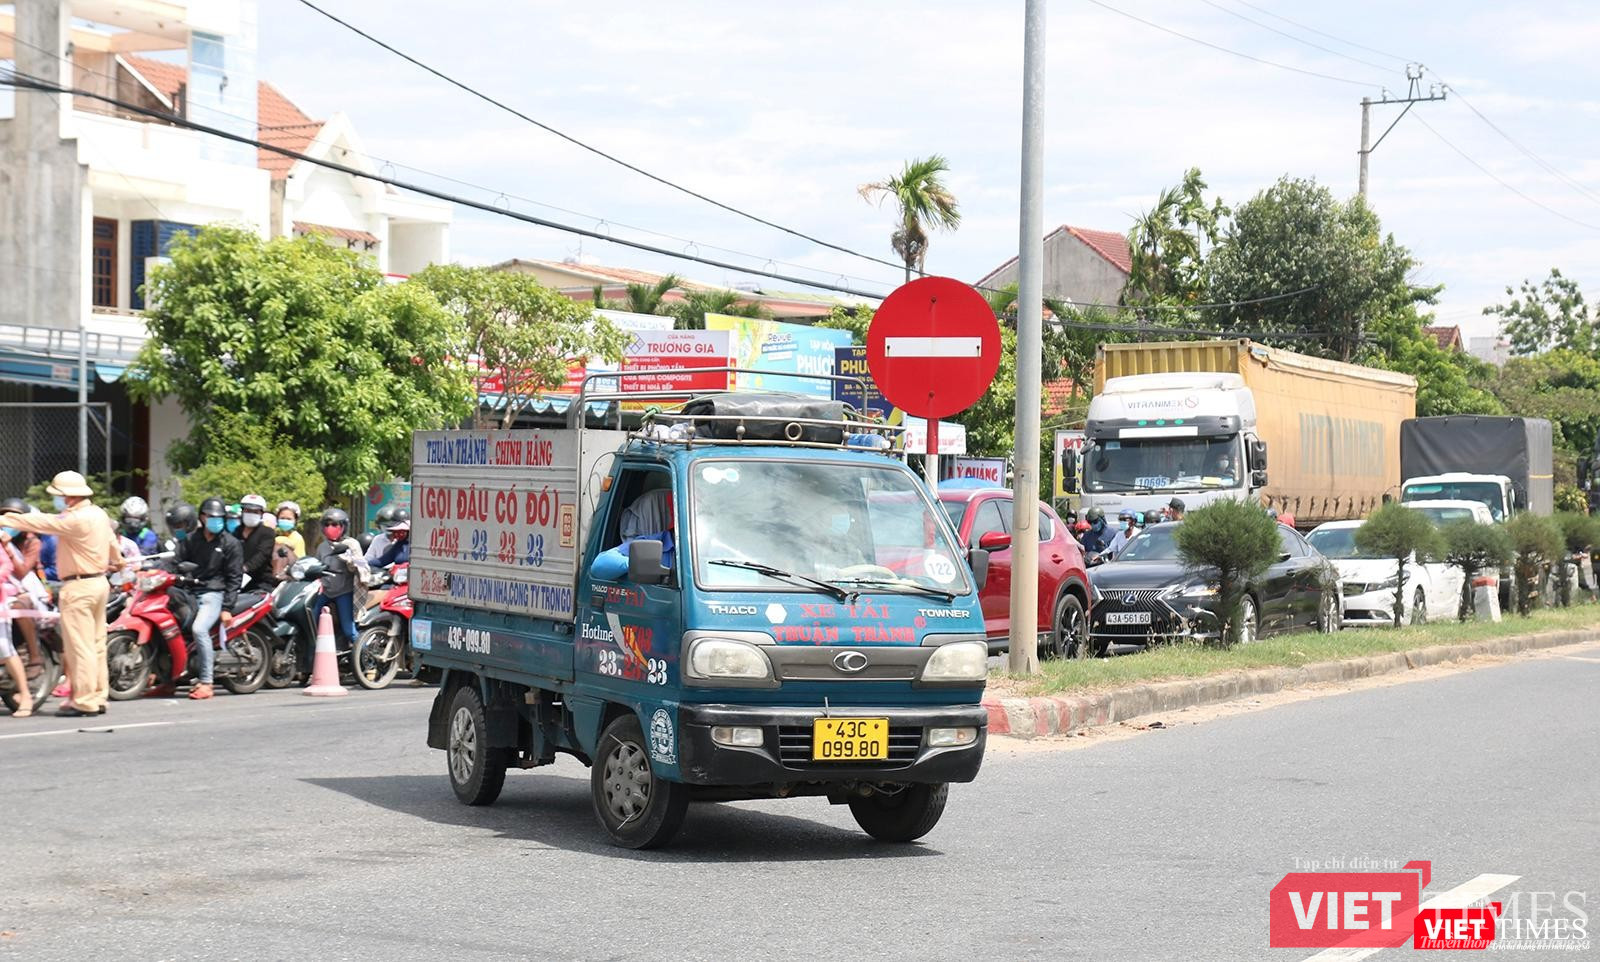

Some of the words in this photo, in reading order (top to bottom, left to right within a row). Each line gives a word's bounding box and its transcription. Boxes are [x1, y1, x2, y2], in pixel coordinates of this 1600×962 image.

[648, 342, 691, 353] TRƯƠNG
[695, 344, 714, 353] GIA
[495, 484, 518, 524] CÓ
[530, 585, 540, 609] TY
[709, 605, 757, 615] THACO
[918, 608, 971, 618] TOWNER
[582, 622, 615, 642] Hotline
[647, 657, 667, 686] 23
[836, 721, 867, 738] 43C
[822, 741, 880, 758] 099.80
